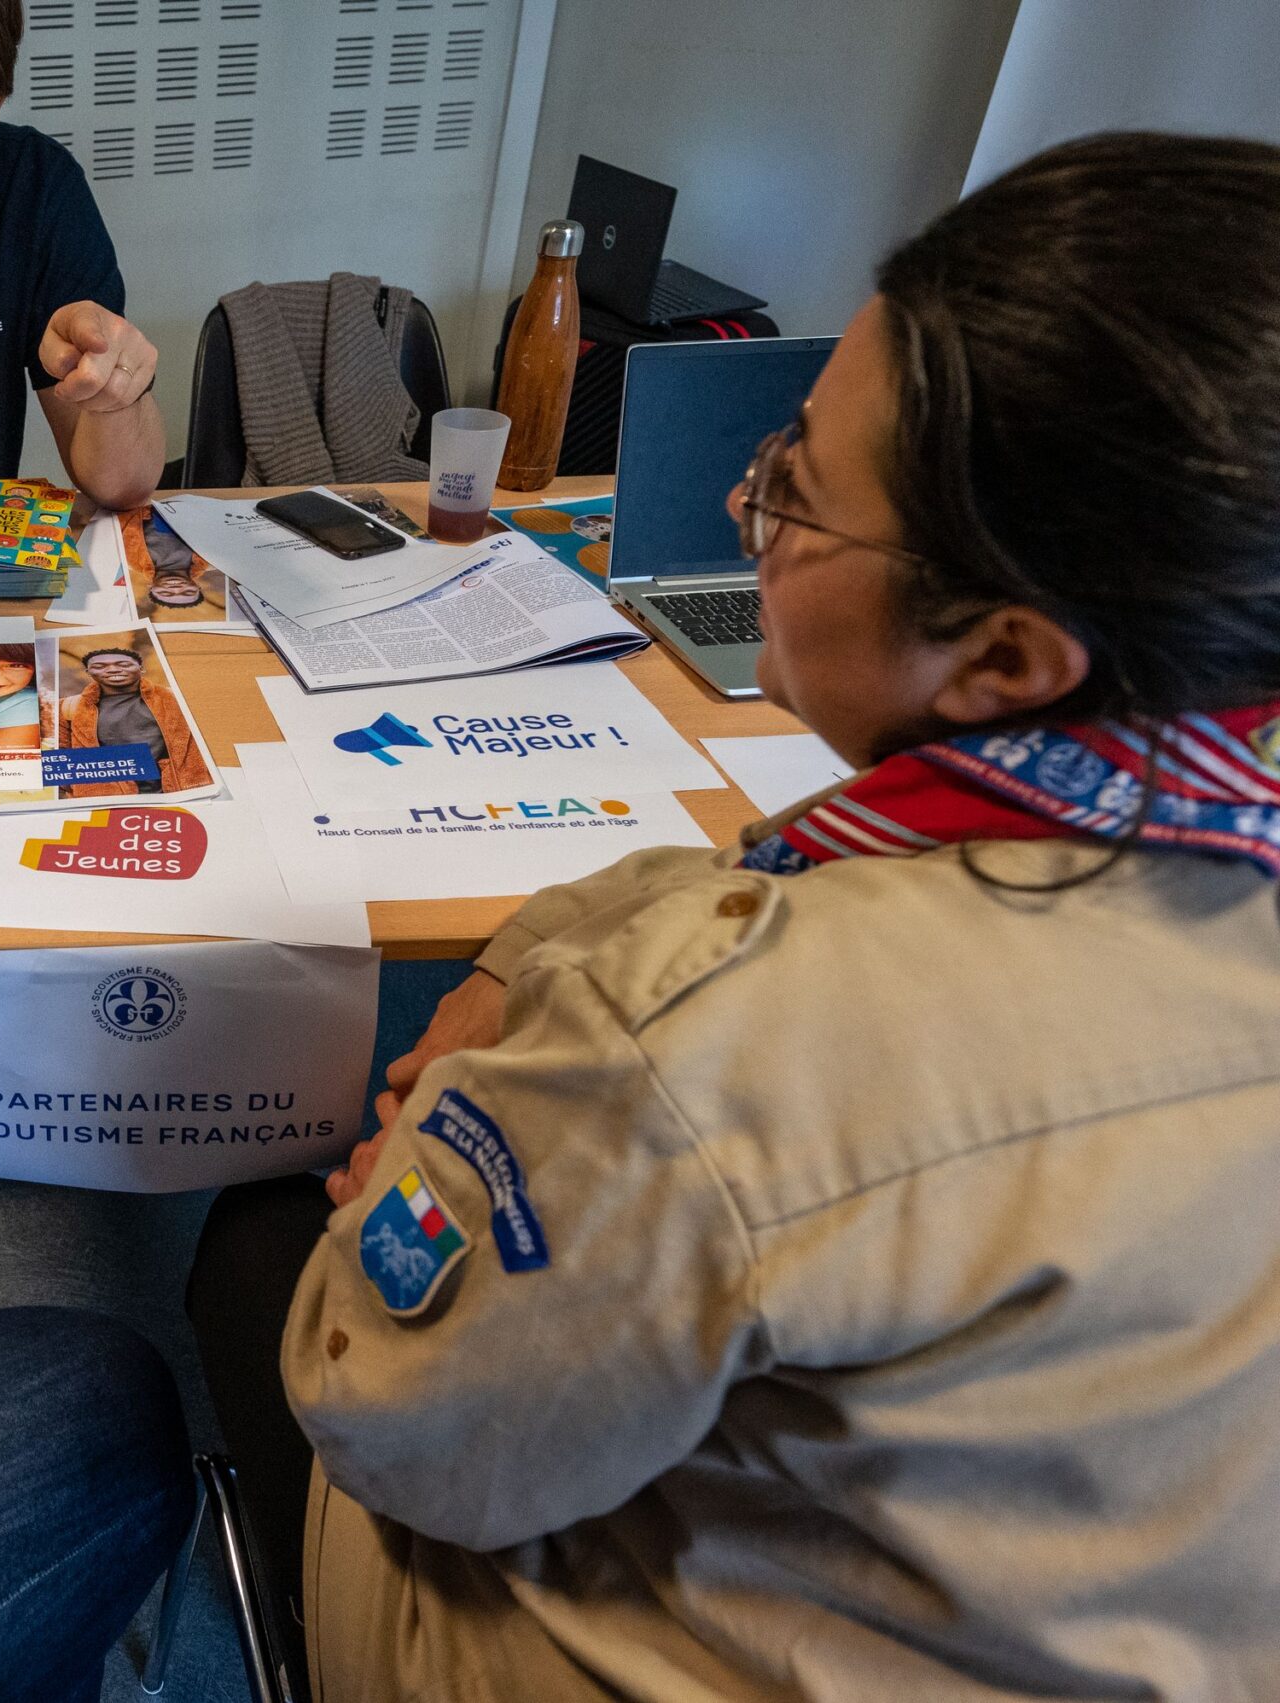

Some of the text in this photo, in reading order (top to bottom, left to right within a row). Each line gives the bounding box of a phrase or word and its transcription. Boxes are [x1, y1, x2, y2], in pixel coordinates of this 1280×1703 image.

[432, 714, 573, 734] Cause
[443, 726, 629, 757] Majeur !
[44, 767, 145, 781] UNE PRIORITÉ !
[66, 760, 116, 771] FAITES
[118, 759, 137, 767] DE
[120, 815, 182, 834] Ciel
[317, 829, 351, 837] Haut
[353, 827, 403, 836] Conseil
[406, 826, 422, 834] de
[441, 823, 487, 833] famille,
[489, 822, 506, 831] de
[509, 820, 566, 830] l'enfance
[569, 819, 586, 828] et
[588, 818, 606, 827] de
[608, 817, 639, 827] l'âge
[119, 834, 182, 854] des
[54, 850, 181, 874] Jeunes
[91, 966, 187, 1002] SCOUTISME FRANÇAIS
[248, 1092, 295, 1112] DU
[159, 1120, 335, 1146] FRANÇAIS
